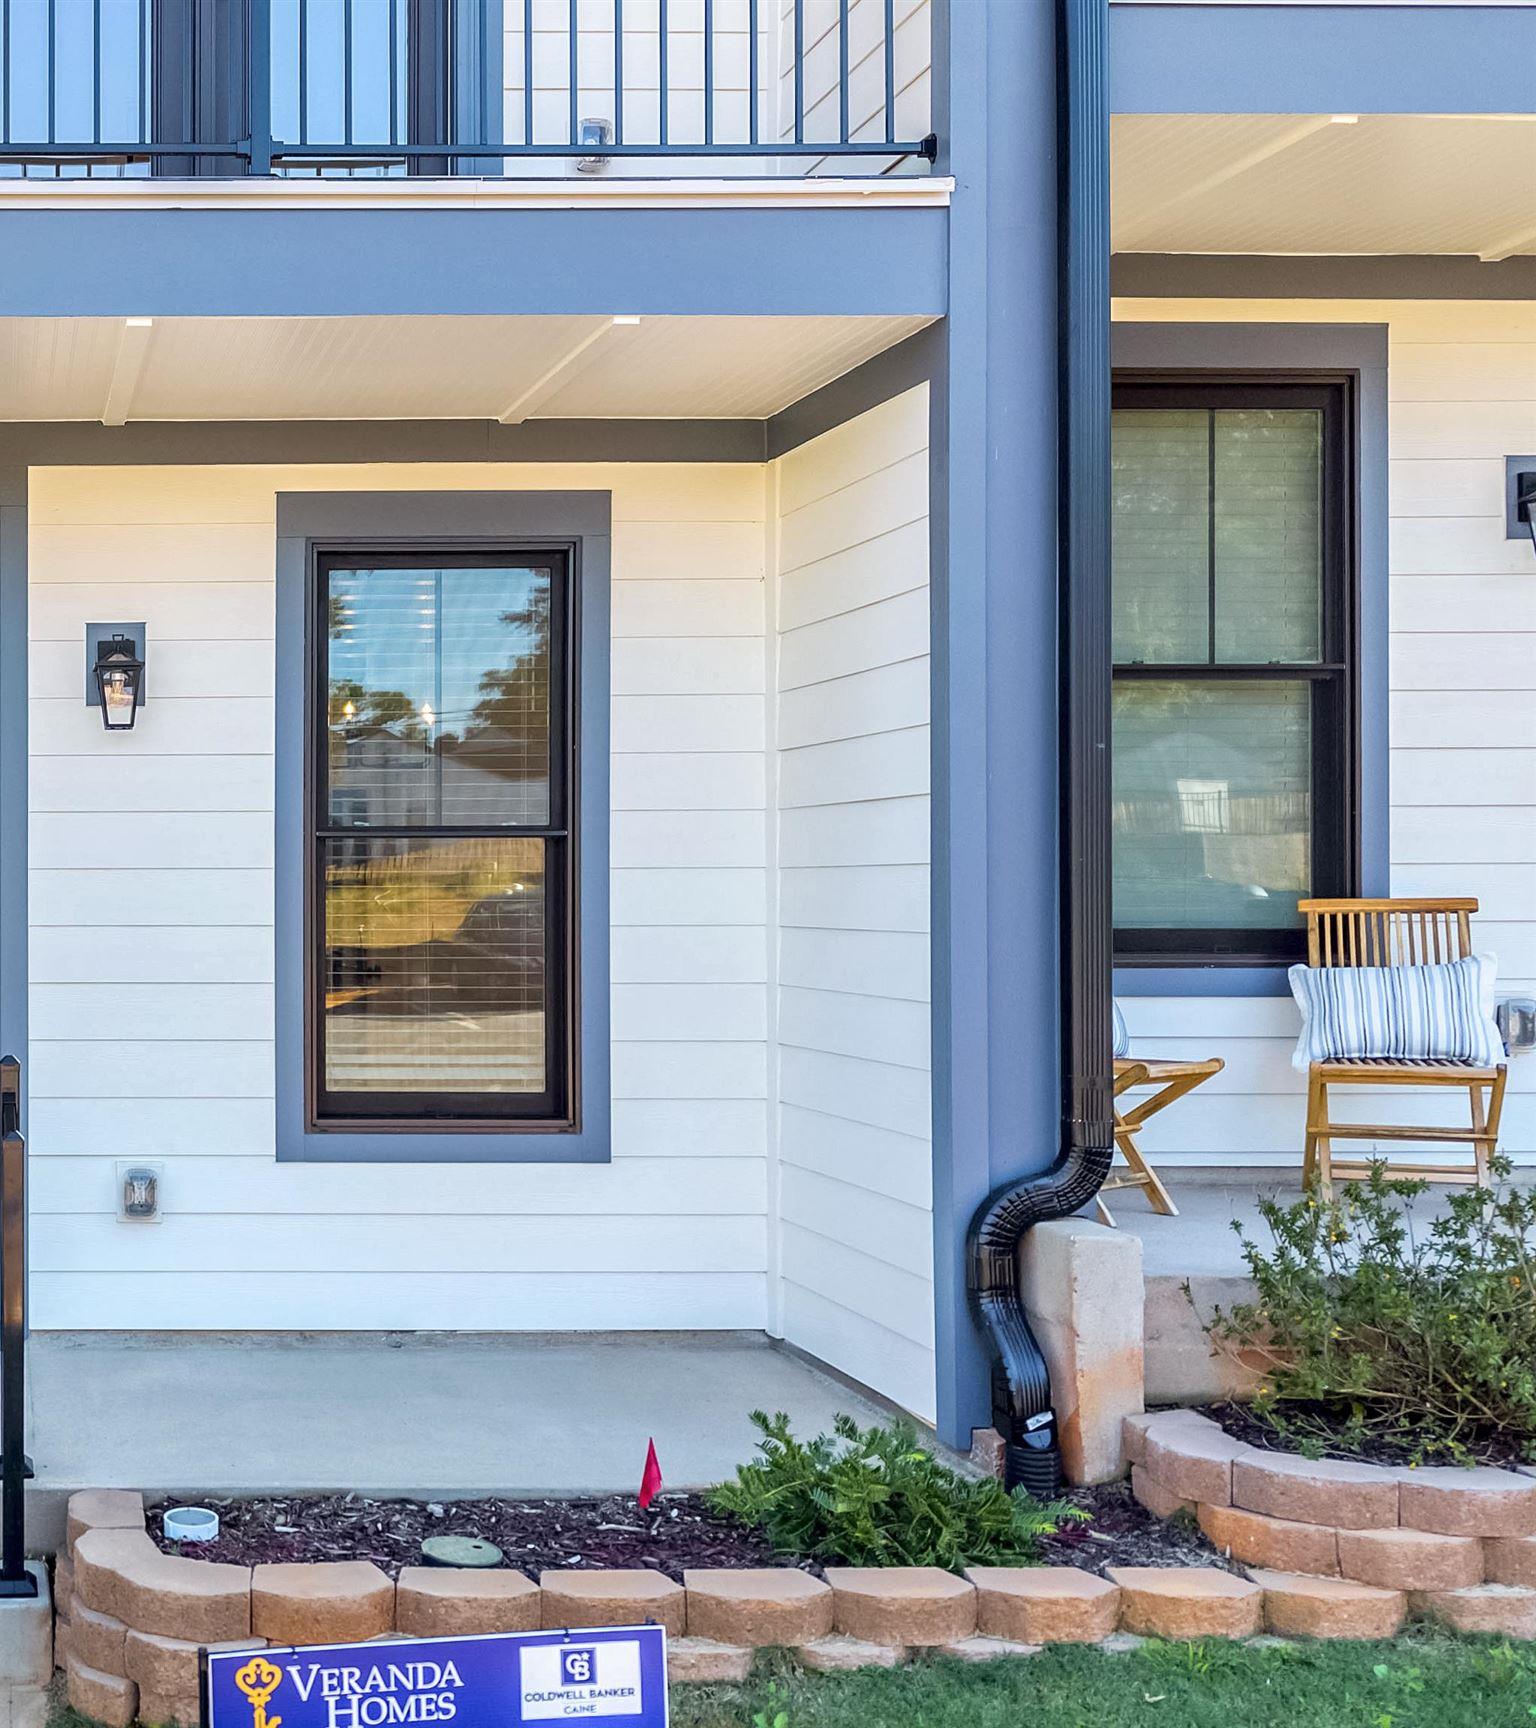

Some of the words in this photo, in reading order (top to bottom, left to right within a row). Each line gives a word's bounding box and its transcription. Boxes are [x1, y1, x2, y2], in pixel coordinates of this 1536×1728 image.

[286, 1660, 465, 1702] VERANDA
[524, 1690, 586, 1703] COLDWELL
[589, 1687, 635, 1699] BANKER
[324, 1691, 457, 1728] HOMES
[564, 1704, 598, 1715] CAINE
